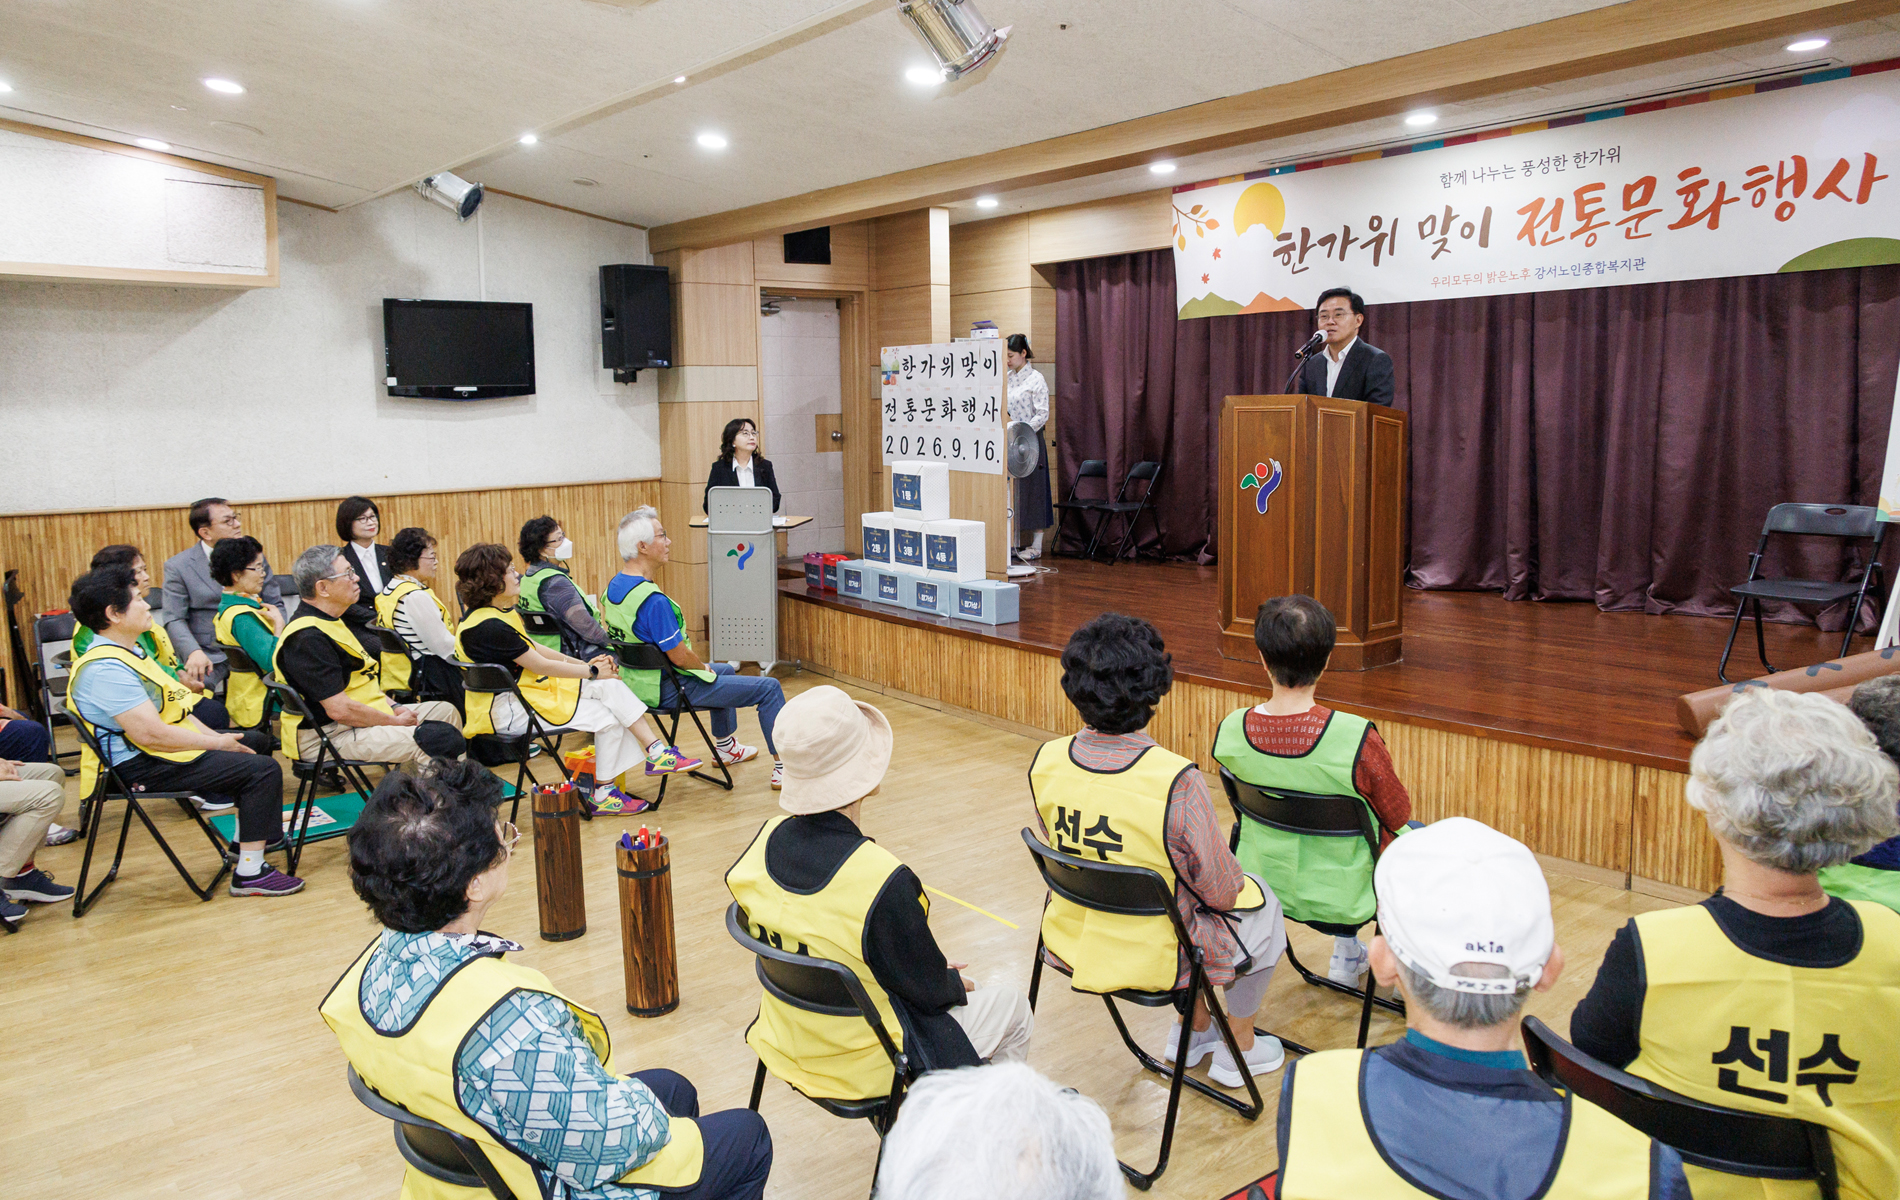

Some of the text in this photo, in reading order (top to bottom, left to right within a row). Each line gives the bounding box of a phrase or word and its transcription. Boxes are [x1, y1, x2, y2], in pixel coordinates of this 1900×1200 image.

[1439, 145, 1622, 189] 함께 나누는 풍성한 한가위
[1272, 151, 1889, 275] 한가위 맞이 전통문화행사
[1430, 256, 1647, 288] 우리모두의 밝은노후 강서노인종합복지관
[901, 349, 998, 380] 한가위맞이
[884, 395, 999, 423] 전통문화행사
[885, 434, 1000, 464] 2026.9.16.
[901, 489, 912, 501] 1등
[871, 543, 881, 554] 2등
[903, 545, 913, 557] 3등
[935, 551, 947, 563] 4등
[1054, 805, 1123, 861] 선수
[1465, 941, 1505, 953] akia
[1711, 1025, 1861, 1107] 선수
